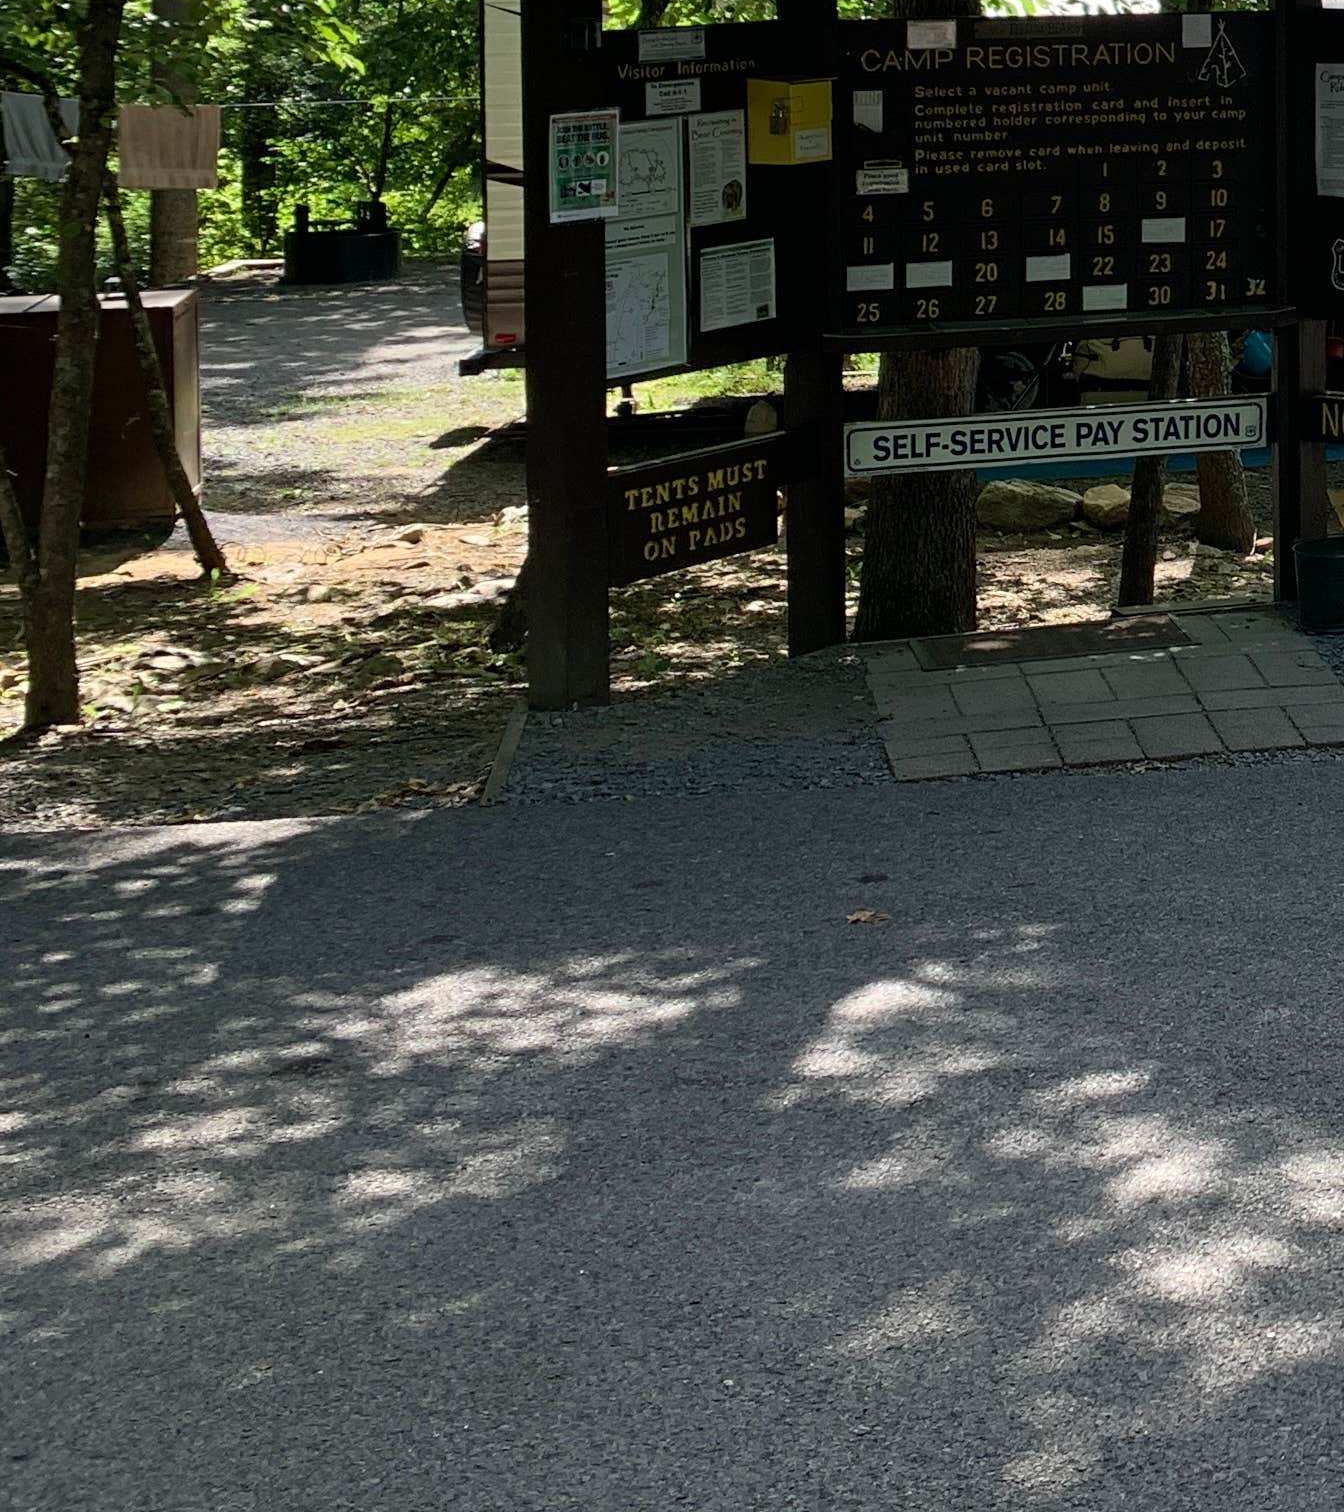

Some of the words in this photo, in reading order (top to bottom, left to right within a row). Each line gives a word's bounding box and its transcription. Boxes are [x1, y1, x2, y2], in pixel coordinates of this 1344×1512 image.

[616, 63, 665, 80] Visitor
[677, 58, 756, 76] Information
[860, 48, 953, 72] CAMP
[966, 41, 1176, 69] REGISTRATION
[914, 85, 963, 99] Select
[968, 87, 977, 97] a
[984, 83, 1033, 97] vacant
[1039, 82, 1077, 96] camp
[914, 103, 984, 119] Complete
[991, 98, 1083, 117] registration
[1092, 98, 1124, 110] card
[1133, 96, 1159, 109] and
[1167, 95, 1212, 107] insert
[1220, 95, 1233, 105] in
[914, 116, 987, 130] numbered
[993, 115, 1038, 127] holder
[1044, 108, 1146, 125] corresponding
[1153, 110, 1167, 121] to
[1174, 110, 1206, 123] your
[1211, 107, 1247, 121] camp
[914, 133, 945, 144] unit
[914, 148, 964, 162] Please
[970, 147, 1021, 159] remove
[1028, 144, 1061, 157] card
[1067, 144, 1105, 155] when
[1109, 142, 1160, 155] leaving
[1165, 139, 1190, 152] and
[1194, 138, 1247, 152] deposit
[915, 164, 928, 175] in
[935, 161, 970, 174] used
[977, 159, 1009, 172] card
[1015, 159, 1048, 171] slot.
[1102, 161, 1108, 177] 1
[1157, 160, 1167, 176] 2
[1212, 159, 1223, 179] 3
[862, 204, 875, 223] 4
[922, 201, 935, 222] 5
[980, 198, 994, 218] 6
[1049, 195, 1063, 215] 7
[1099, 192, 1111, 213] 8
[1155, 190, 1168, 211] 9
[1210, 188, 1228, 208] 10
[863, 236, 874, 255] 11
[922, 232, 940, 253] 12
[980, 230, 999, 251] 13
[1049, 228, 1066, 247] 14
[1098, 225, 1115, 245] 15
[1210, 219, 1227, 238] 17
[975, 262, 999, 283] 20
[1092, 256, 1115, 277] 22
[1150, 253, 1172, 273] 23
[1205, 250, 1227, 271] 24
[856, 302, 881, 323] 25
[916, 298, 940, 319] 26
[975, 295, 998, 315] 27
[1043, 291, 1067, 312] 28
[1149, 285, 1171, 305] 30
[1205, 280, 1226, 301] 31
[872, 423, 1066, 463] SELF-SERVICE
[1075, 420, 1125, 448] PAY
[1131, 412, 1241, 444] STATION
[624, 475, 700, 511] TENTS
[707, 459, 768, 493] MUST
[650, 491, 743, 534] REMAIN
[642, 535, 677, 561] ON
[688, 517, 747, 551] PADS
